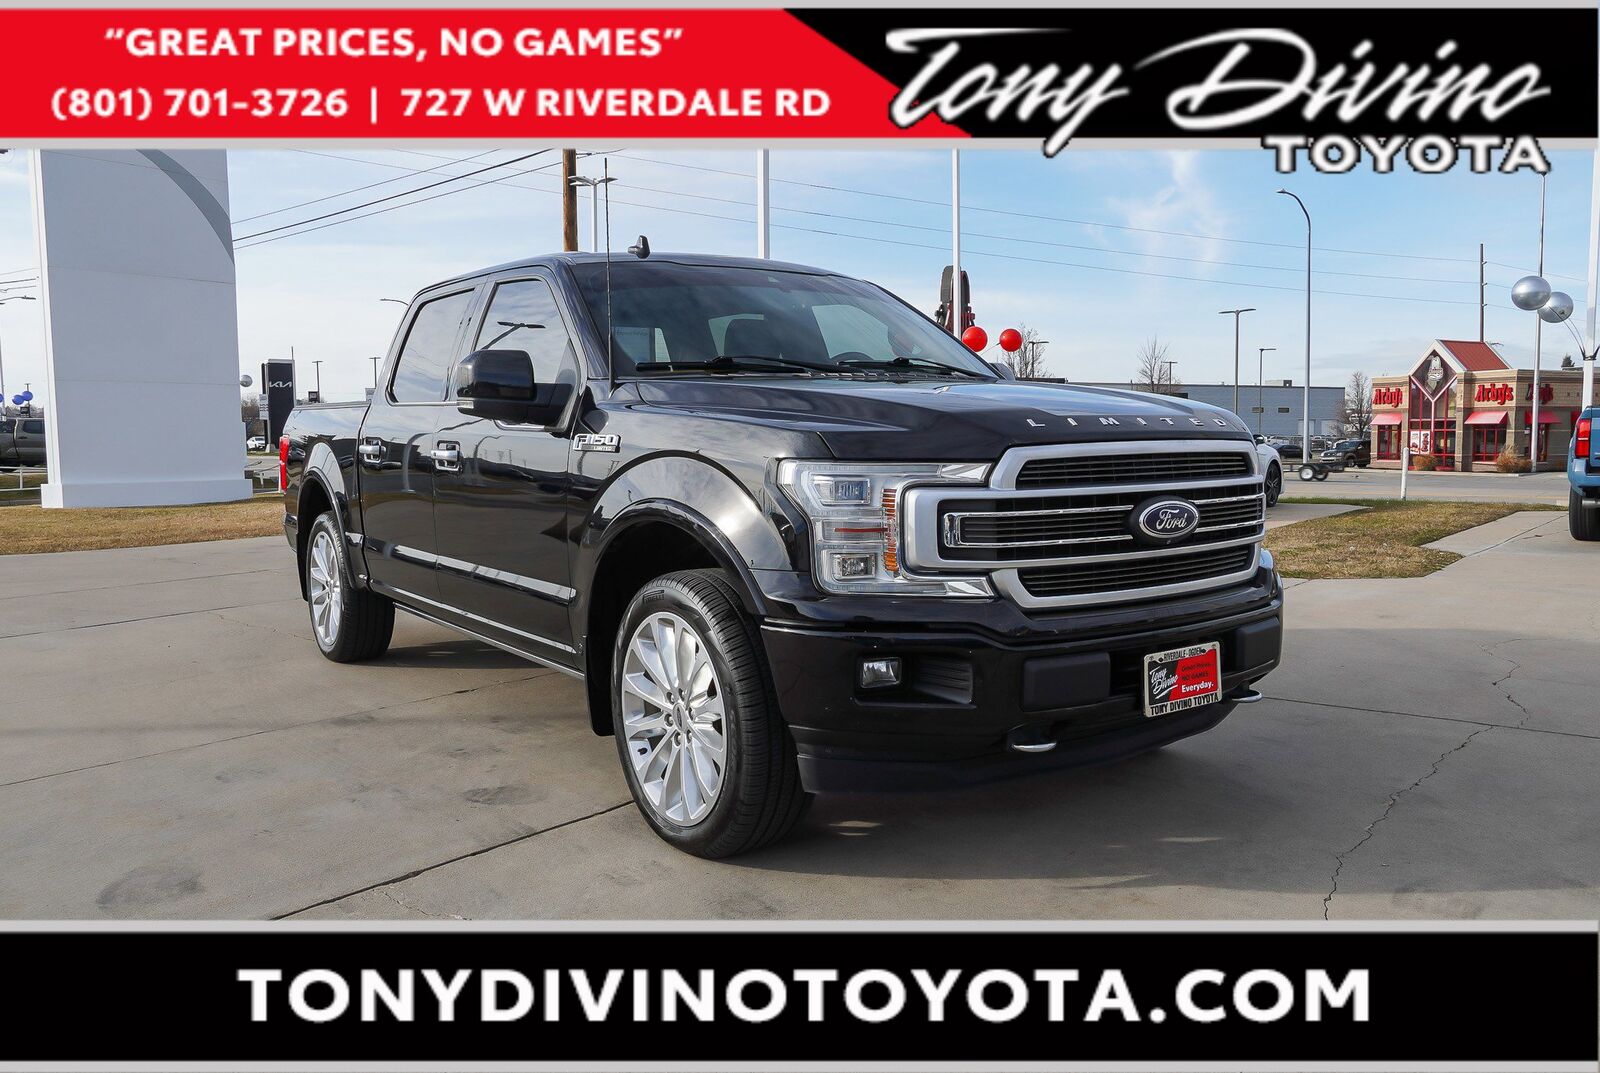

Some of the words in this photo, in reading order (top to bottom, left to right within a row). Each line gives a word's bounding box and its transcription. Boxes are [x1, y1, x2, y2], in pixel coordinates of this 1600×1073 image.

[1475, 383, 1514, 405] Arby's
[1026, 417, 1227, 427] LIMITED
[1156, 508, 1188, 530] Ford
[1149, 666, 1168, 684] Tony
[1151, 675, 1179, 695] Divino
[1181, 680, 1214, 693] Everyday.
[1150, 703, 1169, 716] TONY
[1169, 698, 1192, 712] DIVINO
[1192, 692, 1219, 706] TOYOTA
